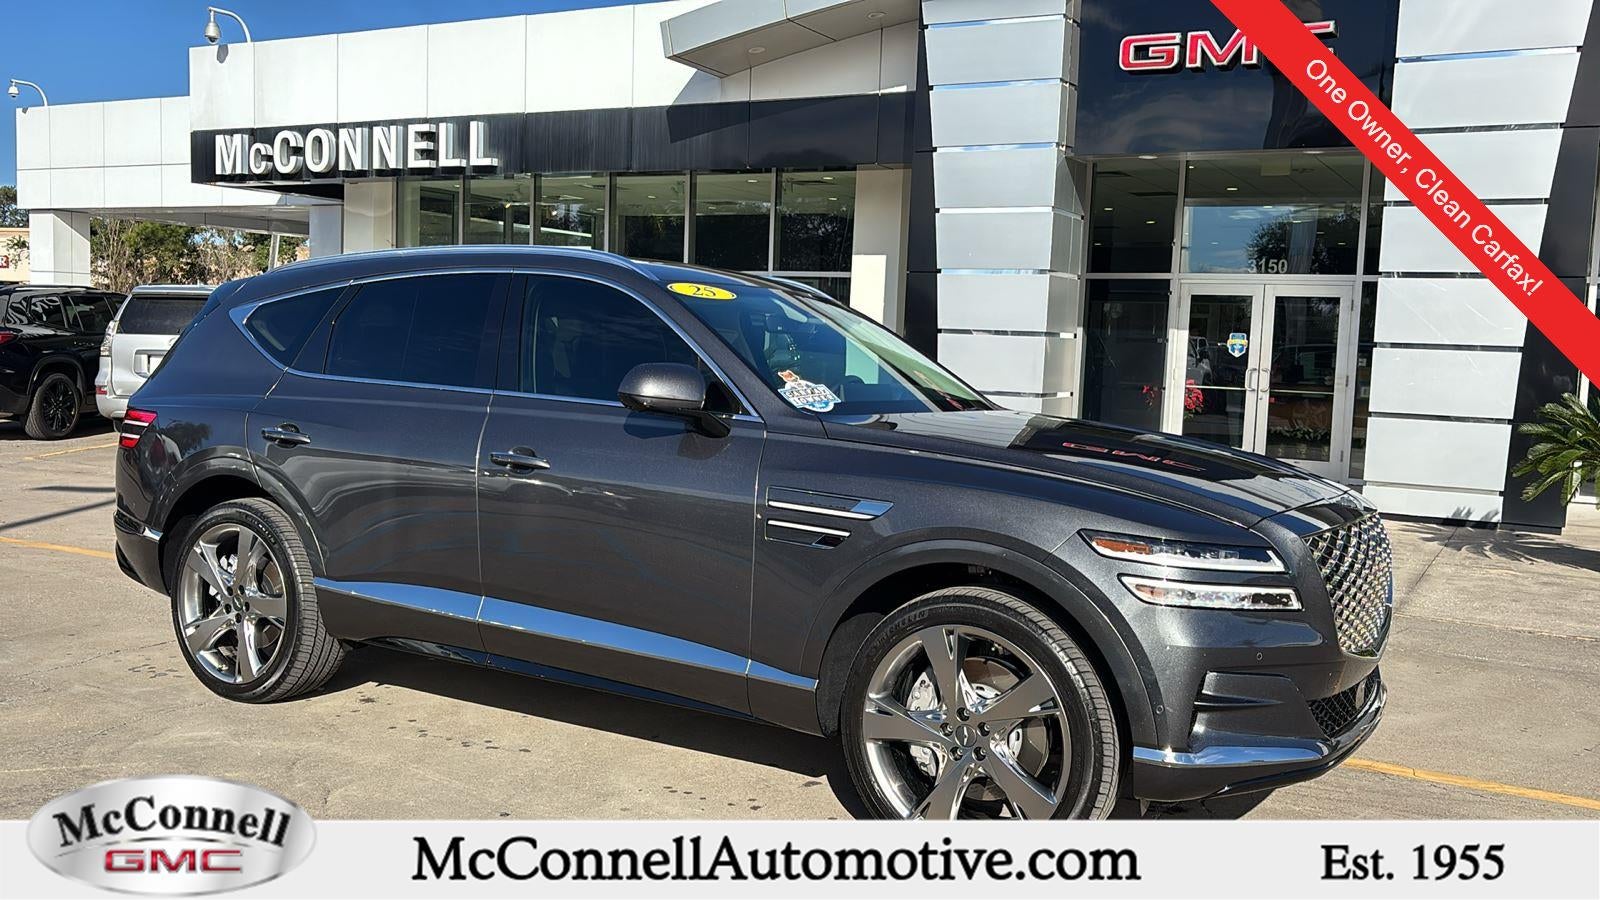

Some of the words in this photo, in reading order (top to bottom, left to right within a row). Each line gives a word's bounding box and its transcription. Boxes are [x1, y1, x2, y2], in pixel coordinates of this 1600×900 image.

[1119, 20, 1337, 71] GM
[215, 121, 498, 175] McCONNELL
[1247, 257, 1288, 274] 3150
[688, 285, 717, 297] 25
